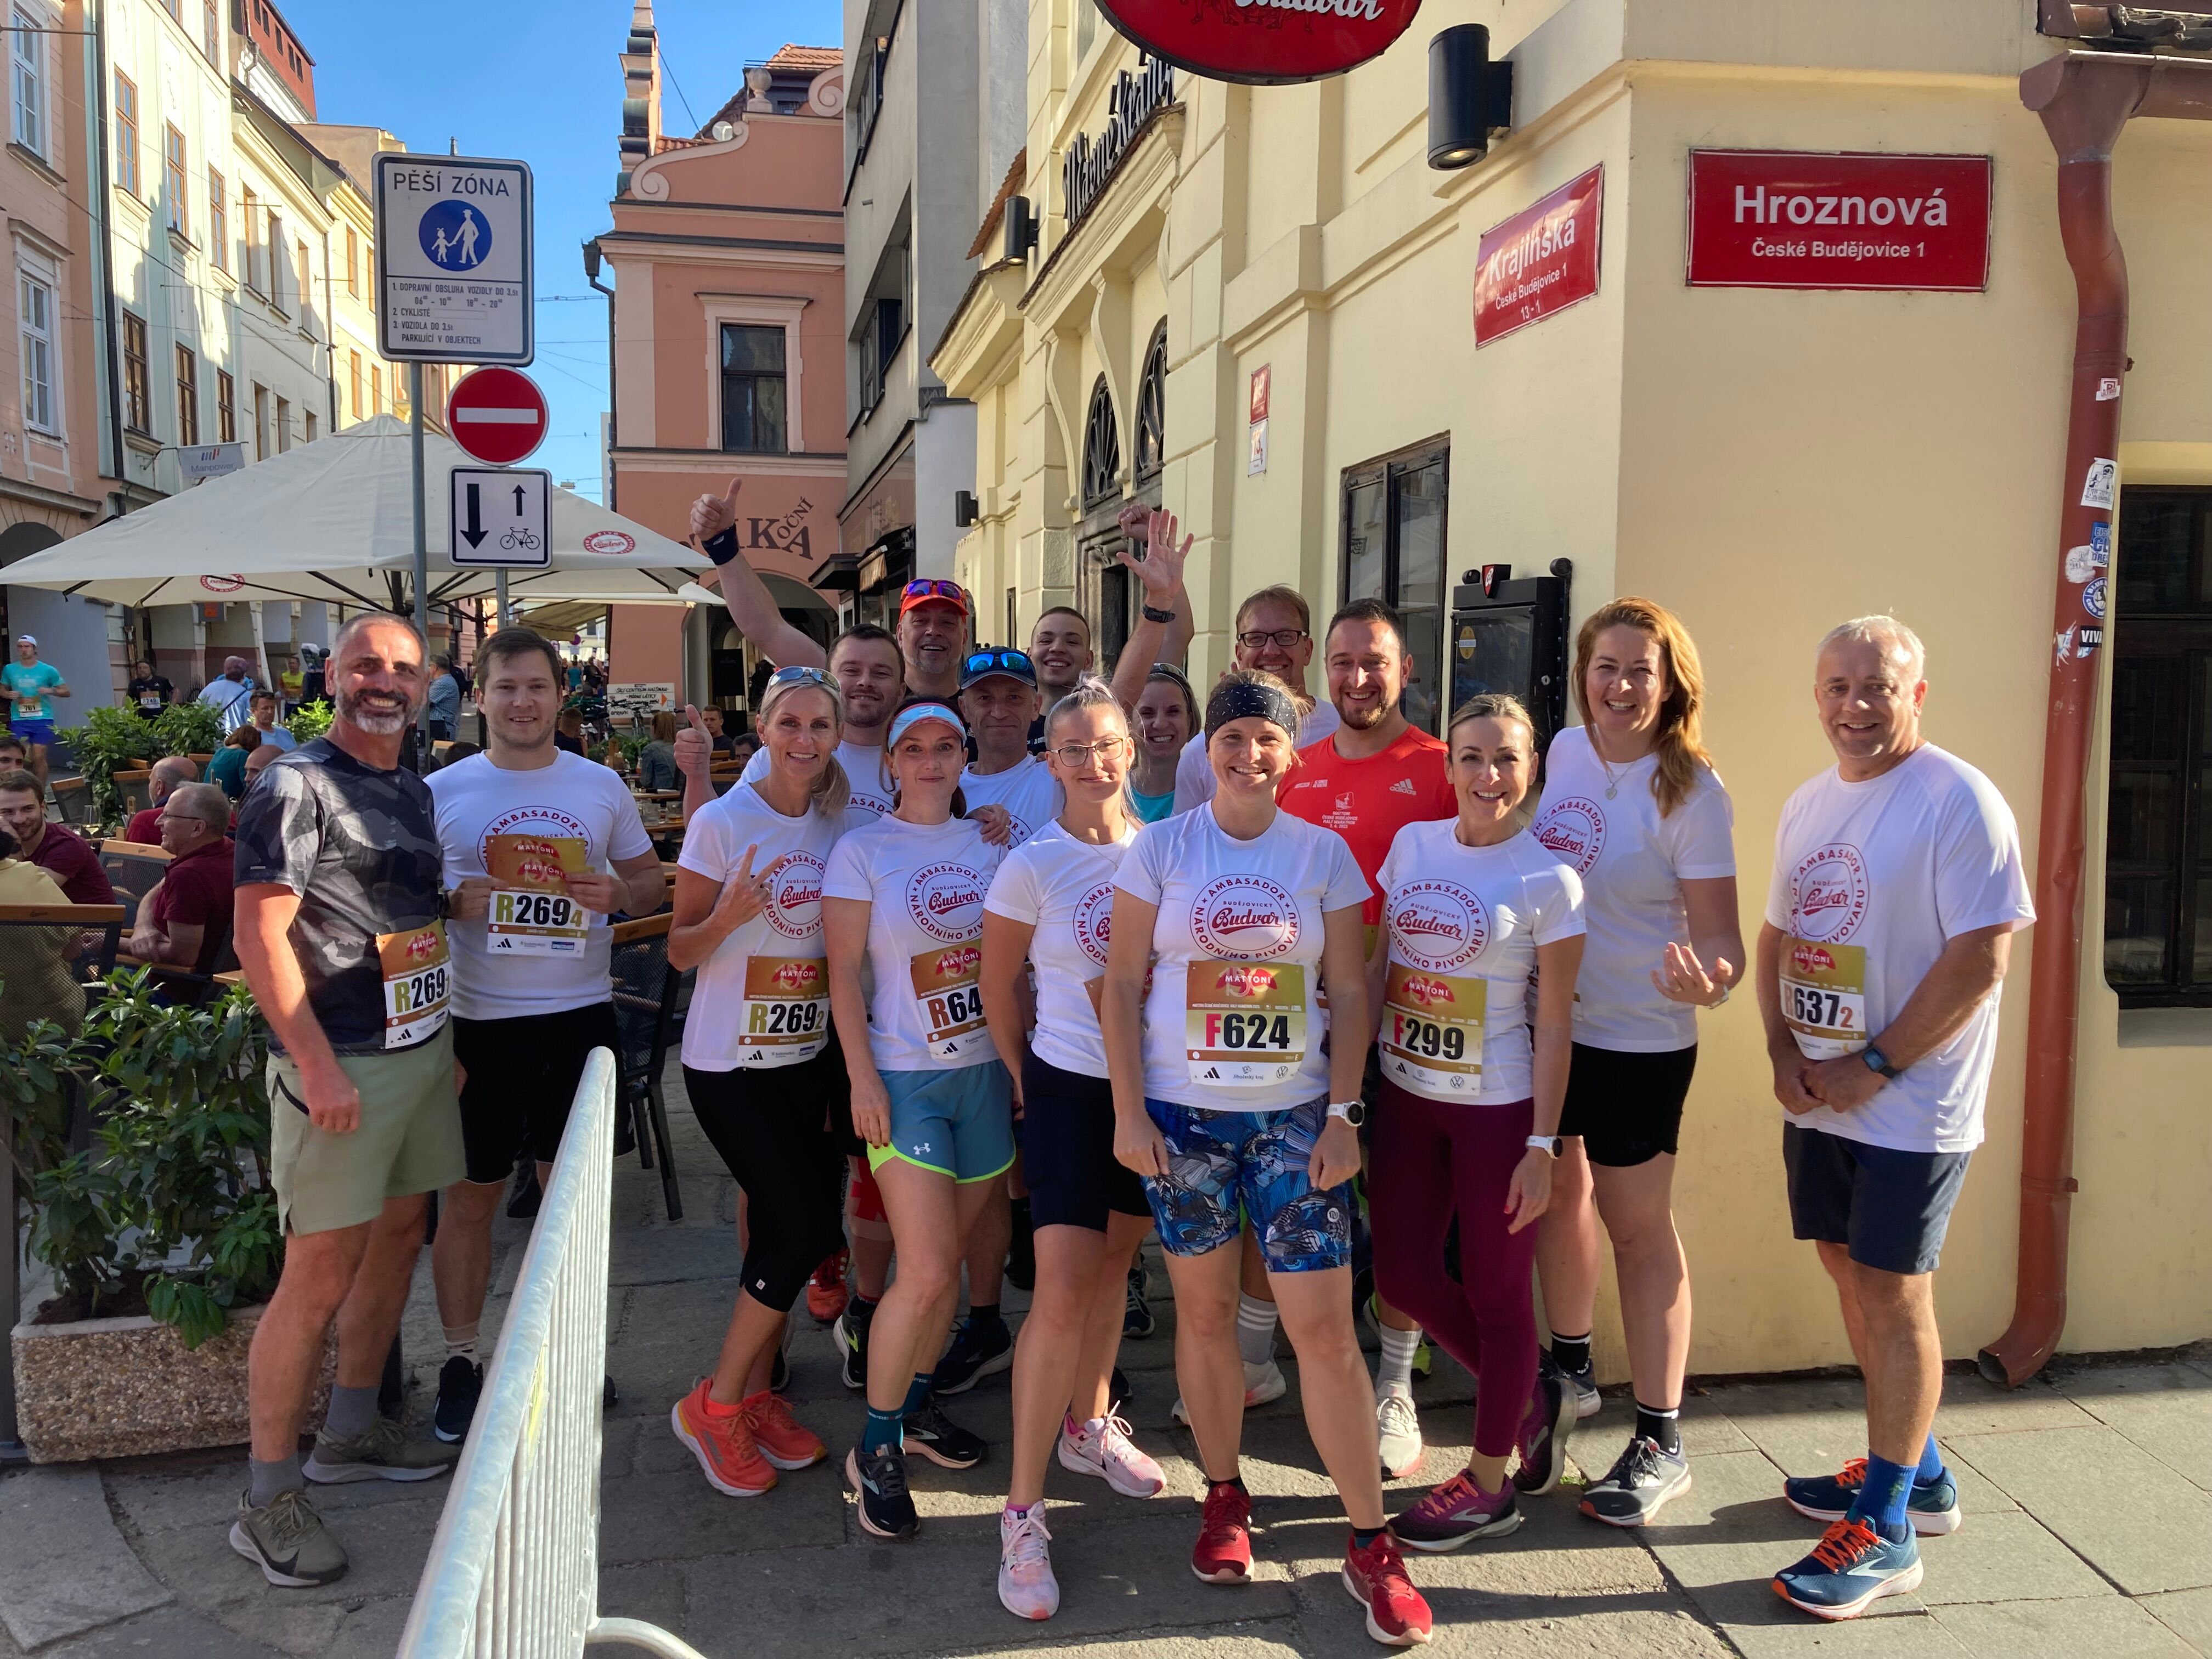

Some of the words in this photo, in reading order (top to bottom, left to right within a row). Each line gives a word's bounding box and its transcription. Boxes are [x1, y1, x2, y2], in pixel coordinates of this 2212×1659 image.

[393, 170, 441, 193] PĚŠÍ
[452, 174, 510, 196] ZÓNA
[1735, 185, 1948, 226] Hroznová
[1489, 208, 1575, 285] Krajinská
[1752, 238, 1807, 257] České
[1812, 241, 1910, 262] Budějovice
[1916, 242, 1925, 257] 1
[400, 283, 432, 292] DOPRAVNÍ
[435, 285, 464, 294] OBSLUHA
[467, 286, 493, 295] VOZIDLY
[1496, 288, 1517, 310] České
[1518, 269, 1560, 299] Budějovice
[1562, 262, 1567, 276] 1
[401, 308, 431, 317] CYKLISTÉ
[1521, 305, 1530, 320] 13
[1536, 300, 1541, 313] 1
[401, 321, 428, 330] VOZIDLA
[402, 333, 434, 343] PARKUJÍCÍ
[445, 335, 481, 345] OBJEKTECH
[191, 463, 234, 472] Manpower
[776, 495, 814, 539] OČNÍ
[1389, 786, 1417, 795] adidas
[492, 810, 578, 834] AMBASADOR
[1551, 802, 1602, 834] AMBASADOR
[517, 844, 554, 854] MATTONI
[1539, 827, 1584, 855] Budvar
[773, 855, 825, 877] AMBASADO
[915, 865, 978, 885] AMBASADOR
[929, 890, 983, 911] Budvar
[1208, 878, 1285, 901] AMBASADOR
[1402, 883, 1480, 916] AMBASADOR
[910, 895, 963, 939] NÁRODNÍHO
[1212, 907, 1282, 929] Budvar
[1396, 910, 1463, 940] Budvar
[1194, 906, 1249, 960] NÁRODNÍHO
[1255, 912, 1298, 958] PIVOVARU
[942, 952, 978, 967] MATTONI
[1435, 928, 1485, 969] PIVOVARU
[1795, 951, 1830, 963] MATTONI
[1225, 975, 1271, 984] MATTONI
[1409, 982, 1448, 997] MATTONI
[927, 986, 983, 1029] R64
[1206, 1013, 1290, 1049] F624
[1394, 1013, 1464, 1060] F299
